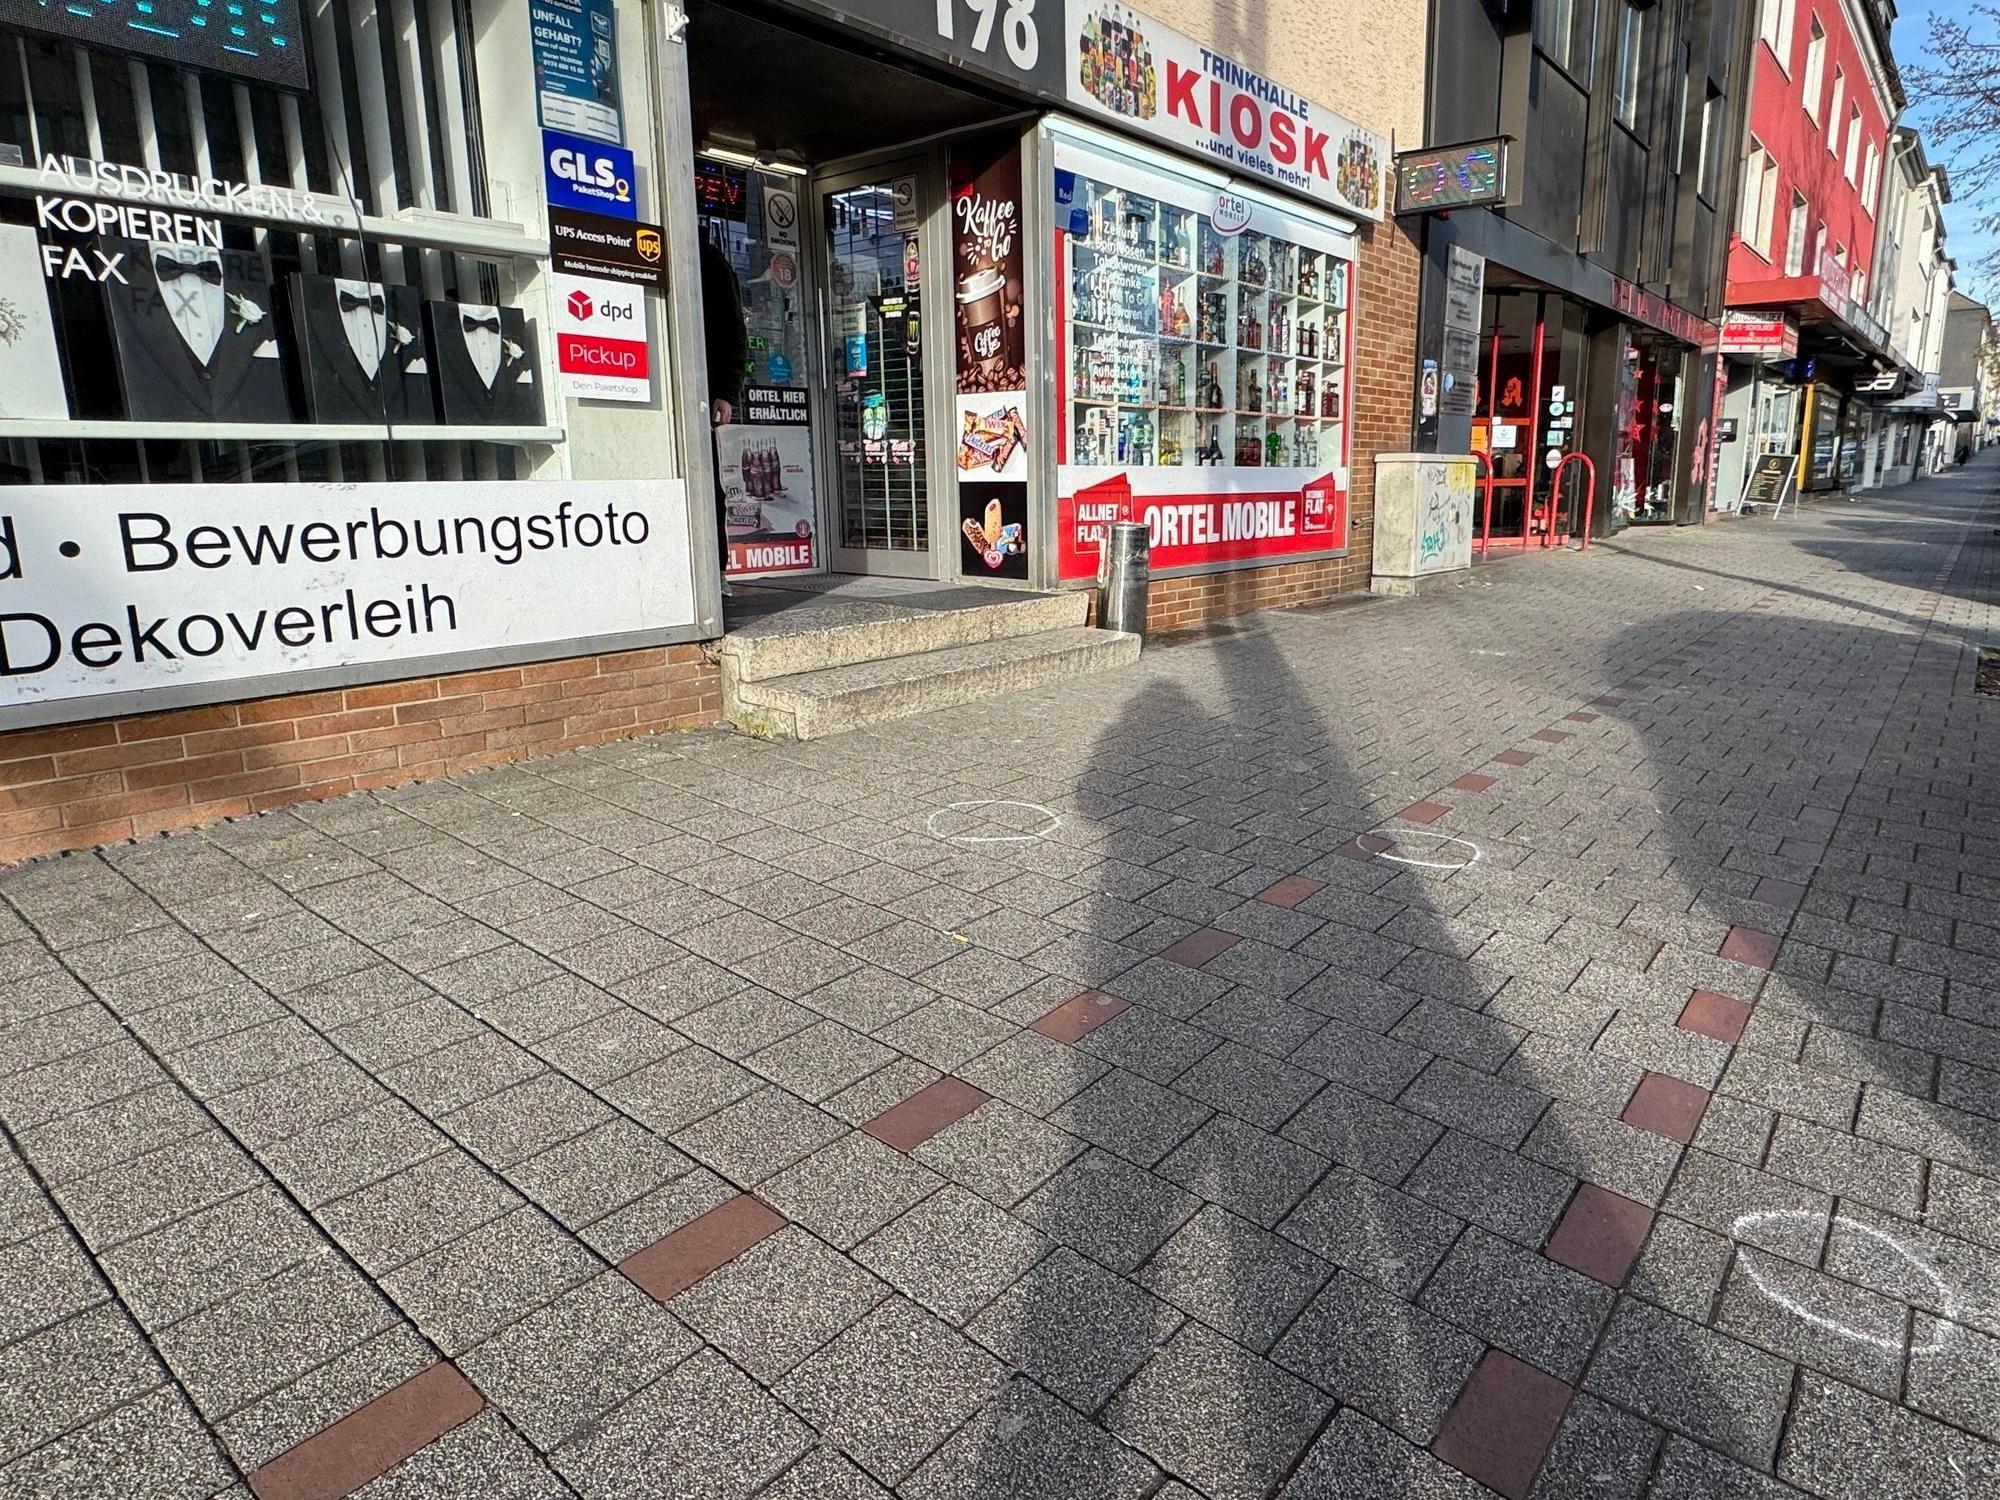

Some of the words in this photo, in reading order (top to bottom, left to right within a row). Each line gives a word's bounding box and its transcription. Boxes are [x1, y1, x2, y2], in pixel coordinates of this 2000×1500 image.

[532, 9, 573, 29] UNFALL
[534, 26, 582, 47] GEHABT?
[1200, 48, 1309, 121] TRINKHALLE
[1166, 59, 1329, 181] KIOSK
[550, 149, 615, 188] GLS
[1195, 137, 1234, 160] ...und
[1238, 149, 1274, 176] vieles
[1277, 169, 1311, 190] mehr!
[39, 153, 295, 216] AUSDRUCKEN
[300, 194, 324, 223] &
[573, 184, 615, 201] PaketShop
[695, 176, 738, 205] EN
[956, 193, 1015, 237] Kaffee
[1219, 195, 1245, 213] ortel
[36, 196, 223, 249] KOPIEREN
[779, 231, 787, 239] NO
[555, 225, 574, 239] UPS
[576, 230, 605, 244] Access
[607, 234, 632, 247] Point
[639, 237, 660, 257] ups
[991, 222, 1011, 262] Go
[41, 246, 129, 285] FAX
[564, 260, 585, 271] Mobile
[600, 300, 633, 322] dpd
[570, 343, 636, 370] Pickup
[572, 381, 593, 390] Dein
[594, 382, 638, 394] Paketshop
[748, 389, 780, 403] ORTEL
[783, 391, 805, 404] HIER
[749, 406, 807, 421] ERHÄLTLICH
[1077, 503, 1119, 522] ALLNET
[1305, 498, 1325, 515] FLAT
[1143, 504, 1219, 548] ORTEL
[1222, 500, 1296, 541] MOBILE
[118, 501, 650, 573] Bewerbungsfoto
[746, 545, 810, 570] MOBILE
[0, 583, 457, 677] Dekoverleih
